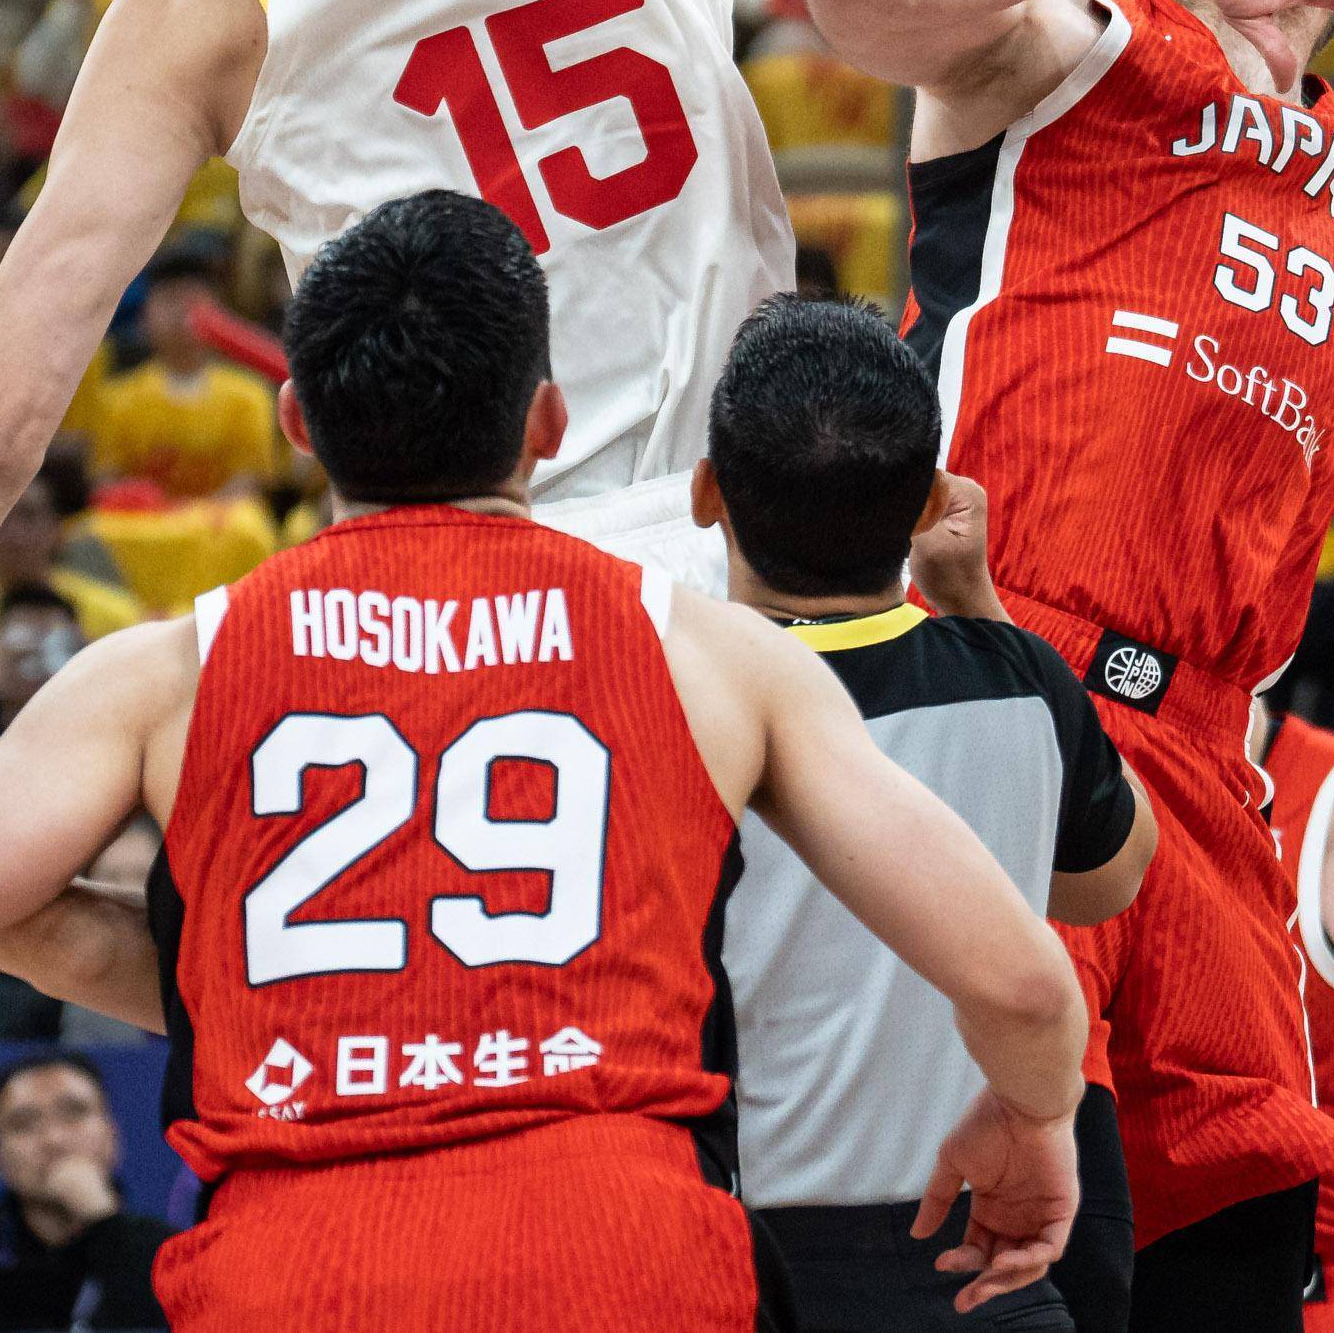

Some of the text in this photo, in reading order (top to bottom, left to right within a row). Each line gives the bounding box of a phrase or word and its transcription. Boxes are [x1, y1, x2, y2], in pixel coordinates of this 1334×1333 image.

[290, 588, 574, 674] HOSOKAWA
[1119, 652, 1147, 697] JPN
[244, 709, 612, 989] 29
[337, 1025, 604, 1096] 日本生命
